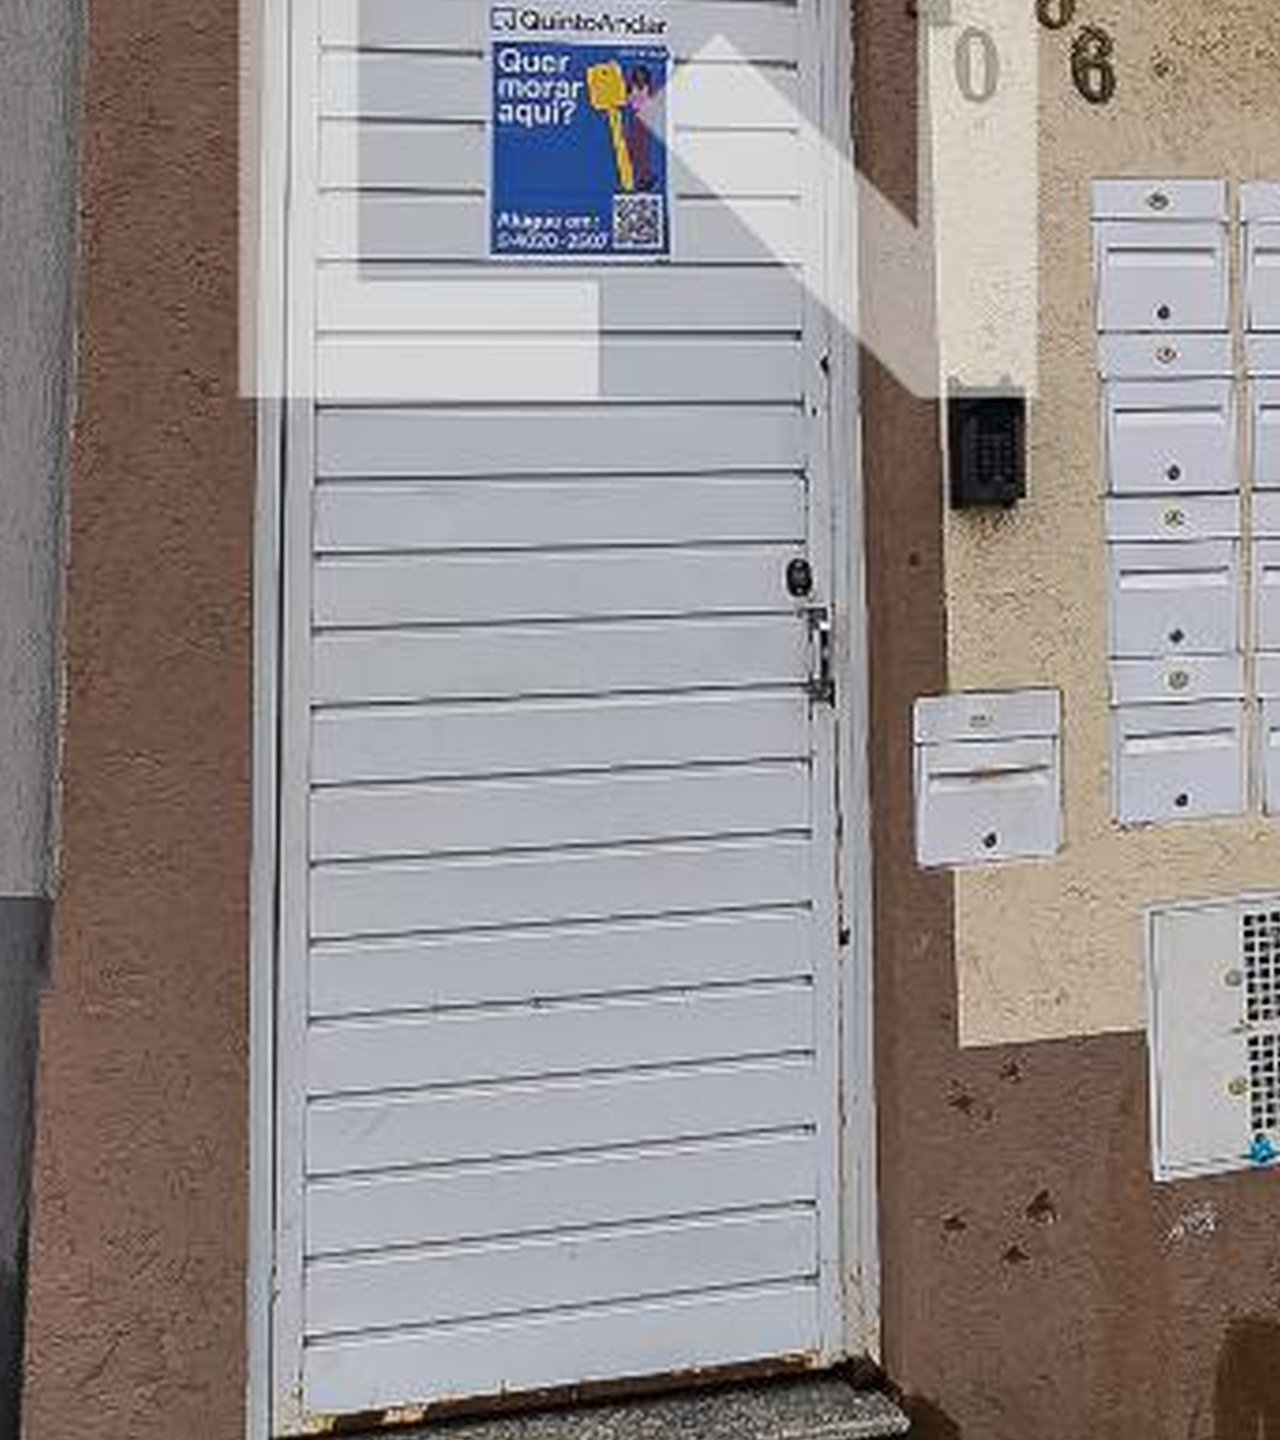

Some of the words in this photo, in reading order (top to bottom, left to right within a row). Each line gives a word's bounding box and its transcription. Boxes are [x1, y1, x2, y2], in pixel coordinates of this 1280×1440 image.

[519, 9, 667, 36] QuintoAndar
[497, 47, 571, 74] Quer
[497, 77, 584, 100] morar
[497, 101, 577, 128] aqui?
